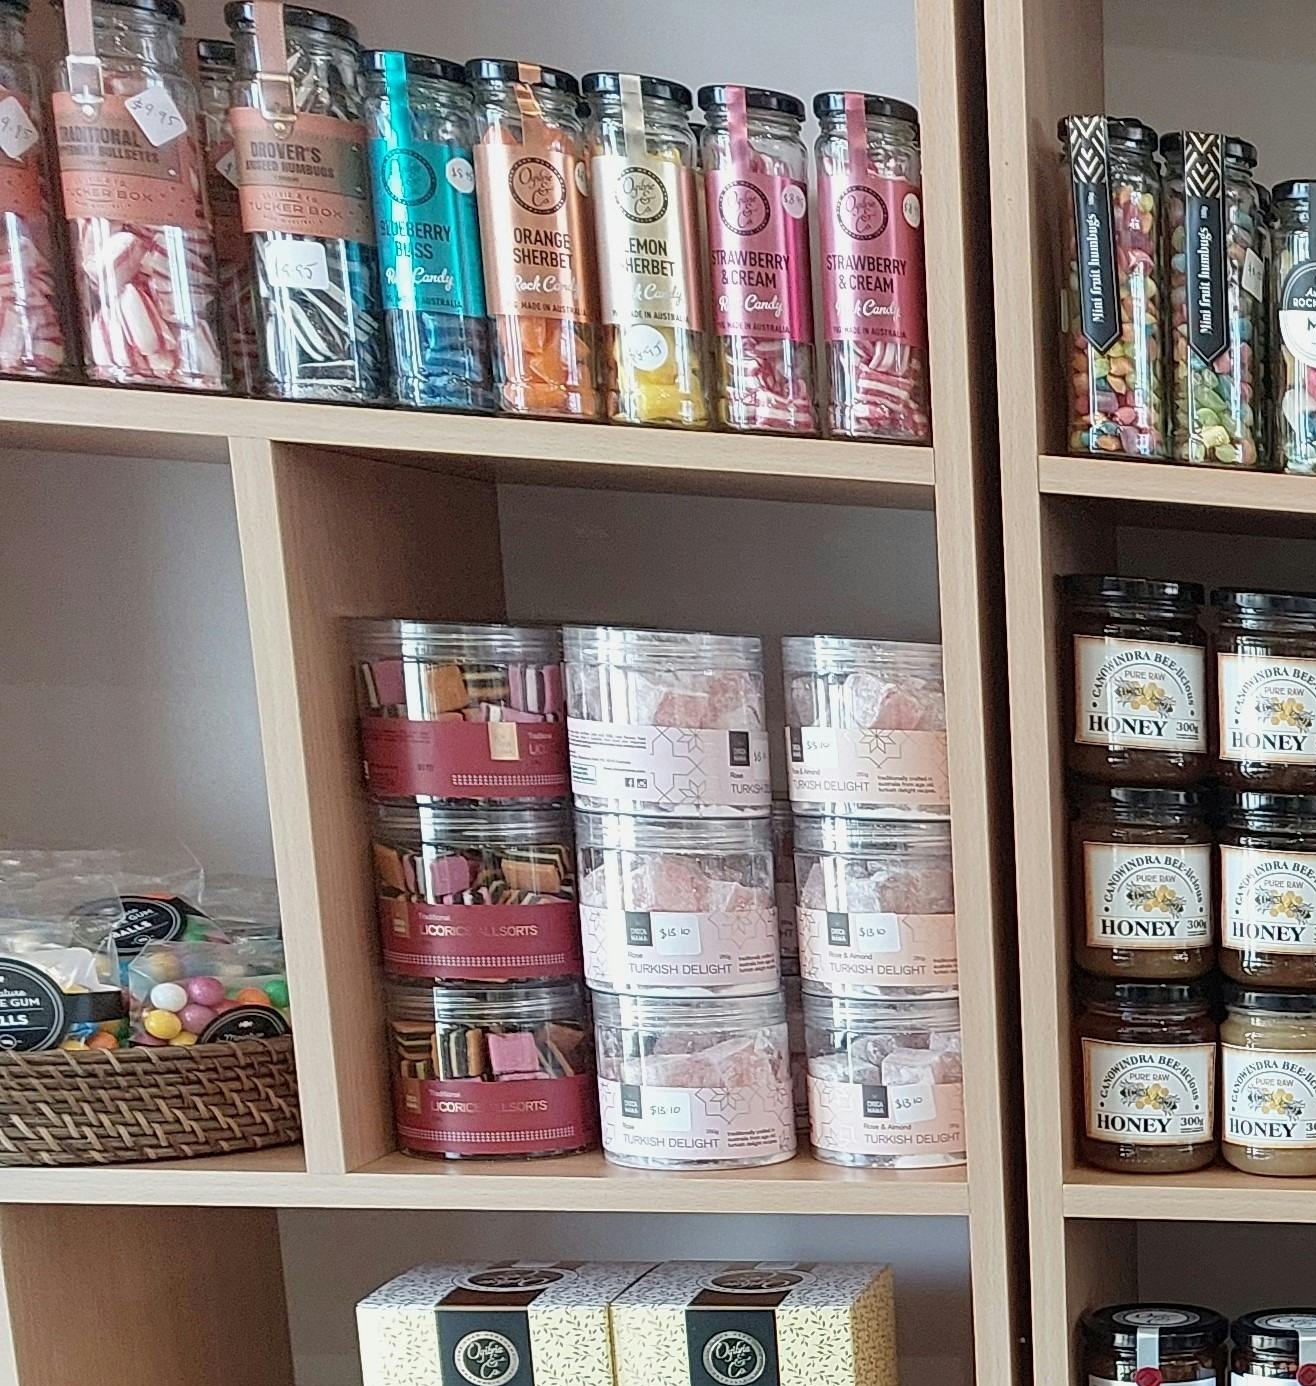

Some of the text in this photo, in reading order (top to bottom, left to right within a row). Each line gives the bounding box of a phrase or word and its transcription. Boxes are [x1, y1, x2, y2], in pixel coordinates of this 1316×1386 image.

[250, 141, 322, 163] DROVER'S
[248, 201, 344, 219] TUCKER BOX
[514, 227, 571, 248] ORANGE
[512, 247, 574, 269] SHERBET
[711, 249, 790, 270] STRAWBERRY
[721, 269, 777, 289] & CREAM
[1088, 714, 1168, 737] HONEY
[628, 962, 732, 975] TURKISH DELIGHT
[829, 963, 926, 976] TURKISH DELIGHT
[1096, 1113, 1205, 1134] HONEY 300g
[1229, 1120, 1297, 1139] HONEY
